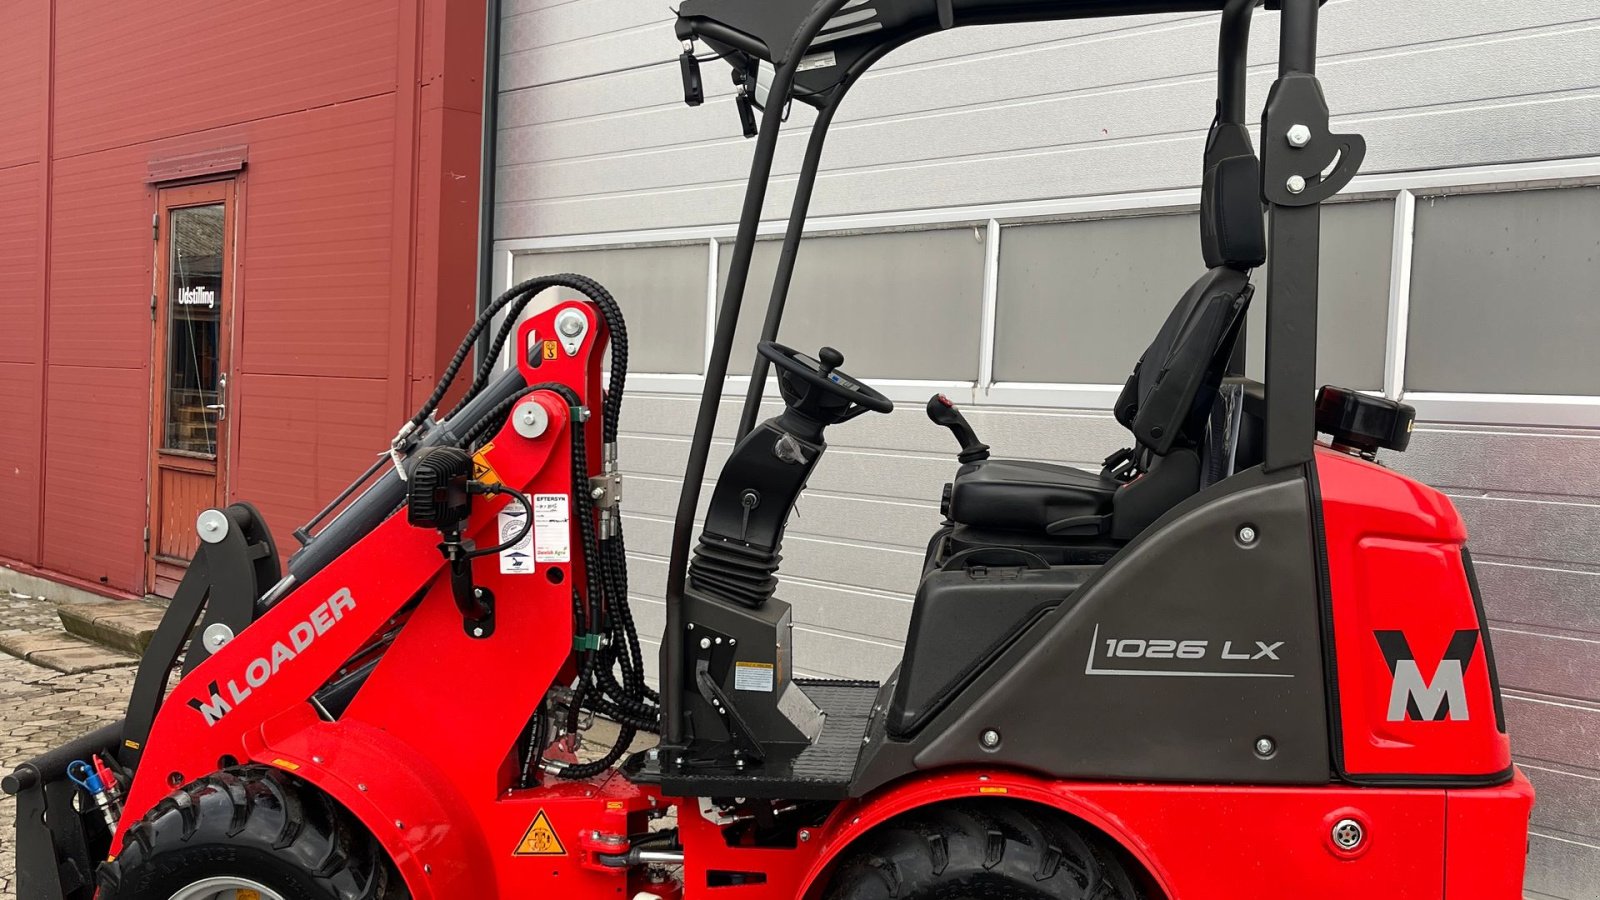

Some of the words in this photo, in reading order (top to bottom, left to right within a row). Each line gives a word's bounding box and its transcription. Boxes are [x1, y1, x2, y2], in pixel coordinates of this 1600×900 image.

[179, 286, 215, 308] Udstilling
[1106, 639, 1208, 659] 1026
[1221, 641, 1285, 660] LX
